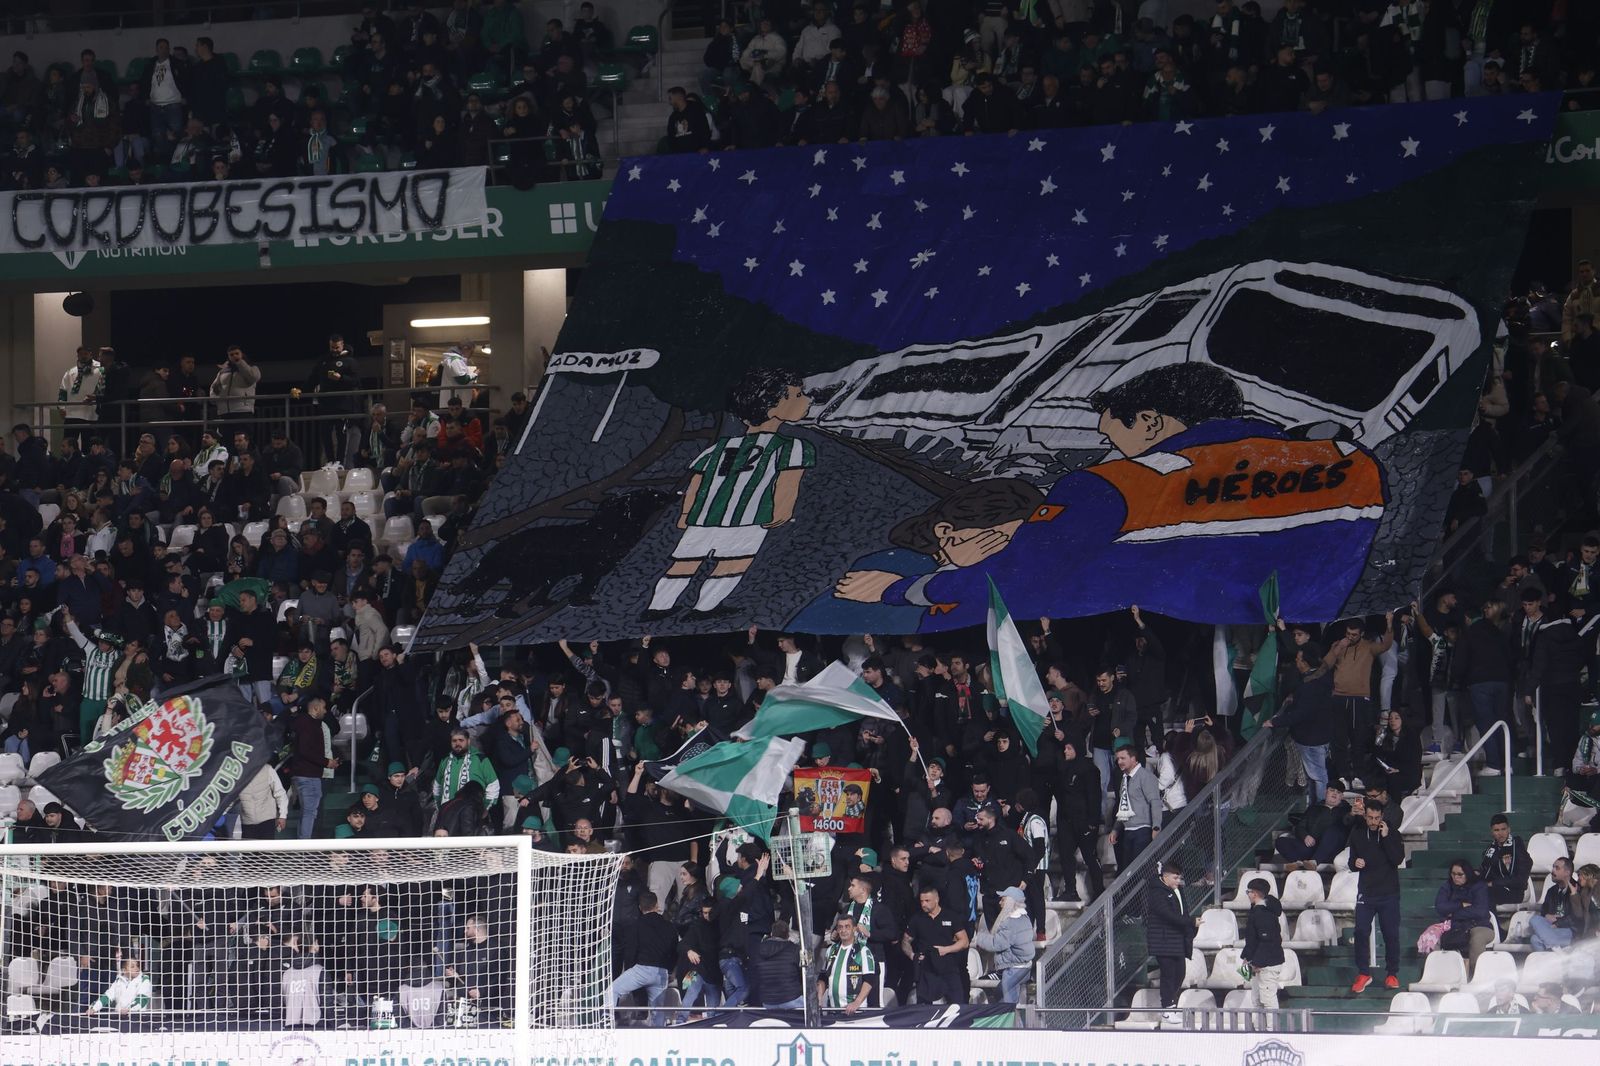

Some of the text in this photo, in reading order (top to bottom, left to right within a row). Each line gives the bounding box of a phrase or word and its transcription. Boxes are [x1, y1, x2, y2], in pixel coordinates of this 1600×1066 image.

[13, 171, 450, 249] CORDOBESISMO
[550, 351, 642, 368] ADAMUZ
[1185, 459, 1353, 506] HÉROES
[161, 741, 254, 841] CÓRDOBA
[812, 819, 844, 832] 14600
[412, 997, 431, 1012] 013
